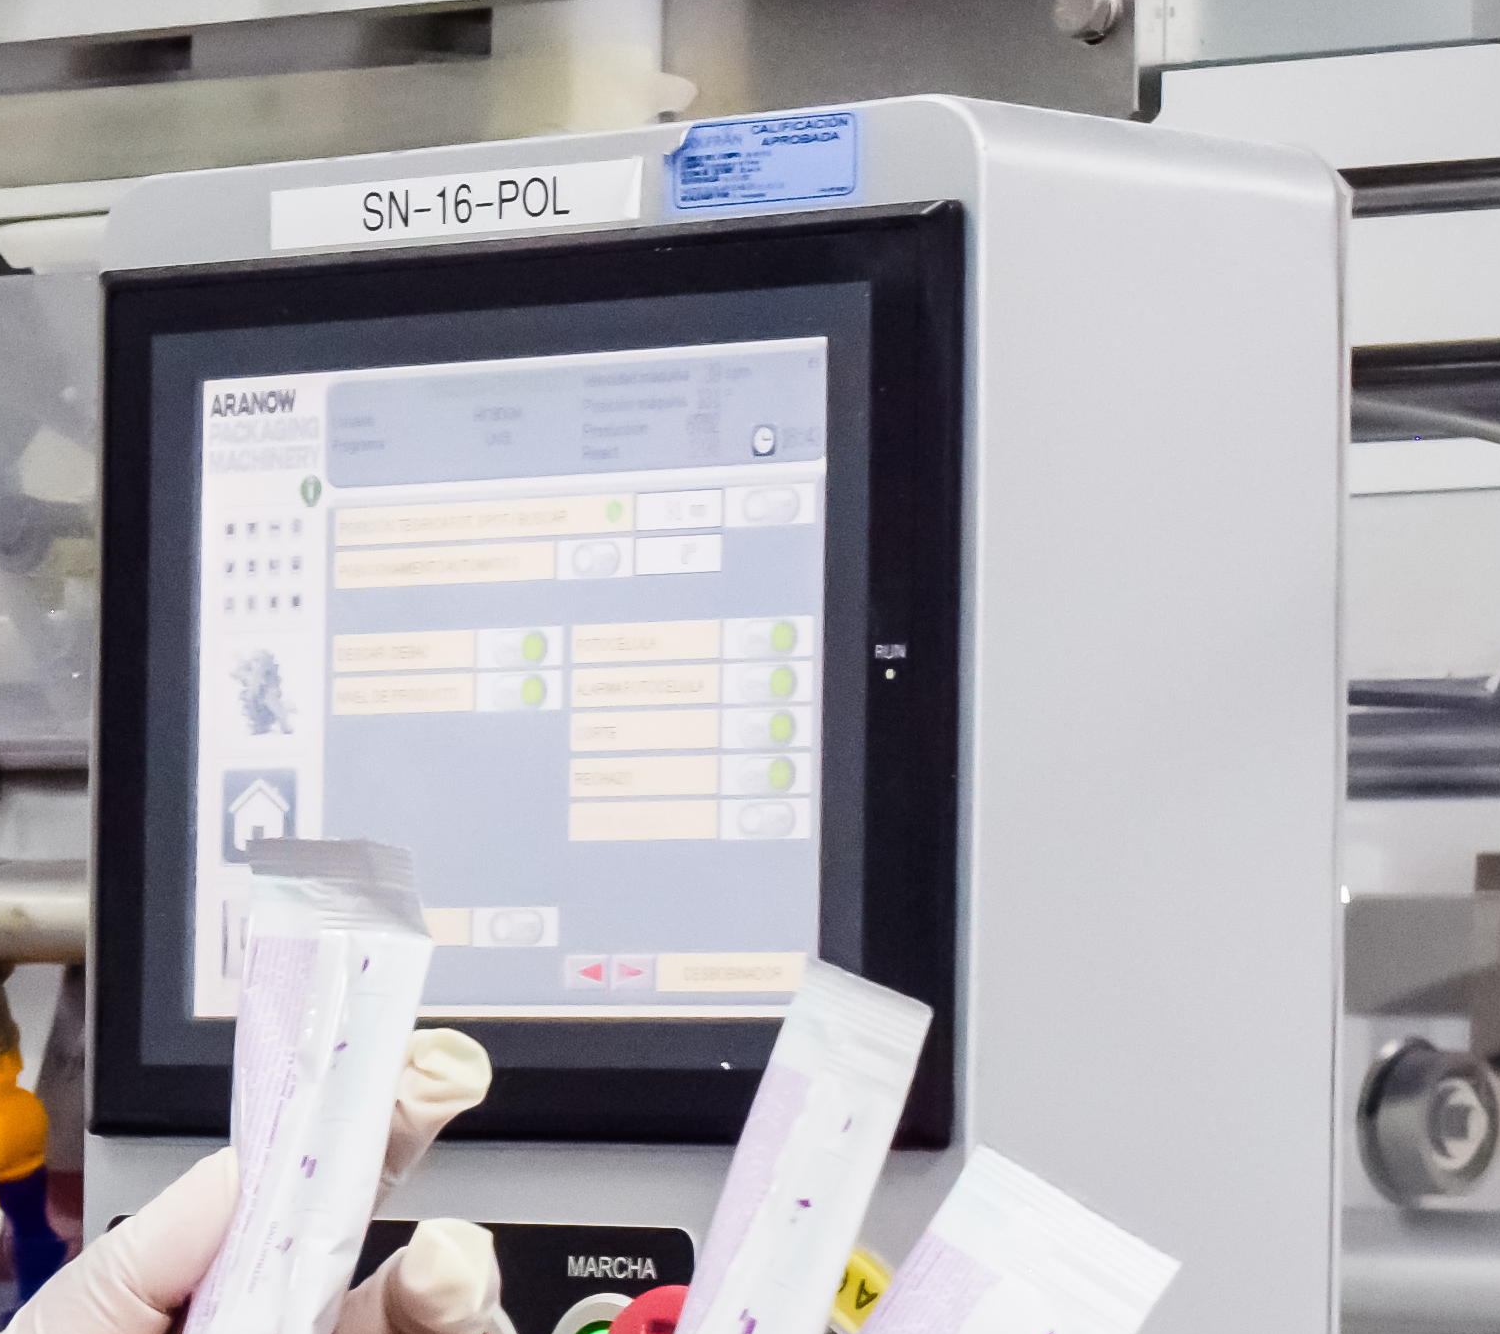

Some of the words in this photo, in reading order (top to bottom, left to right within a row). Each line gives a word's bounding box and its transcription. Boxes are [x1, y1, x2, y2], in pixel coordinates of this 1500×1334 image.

[761, 131, 840, 146] APROBADA
[363, 176, 570, 231] SN-16-POL
[210, 389, 297, 417] ARANOW
[209, 416, 320, 443] PACKAGING
[208, 443, 321, 474] MACHINERY
[875, 644, 907, 659] RUN
[372, 689, 388, 704] DE
[391, 687, 460, 703] PRODUCTO
[574, 771, 634, 786] RECHAZO
[567, 1256, 658, 1279] MARCHA
